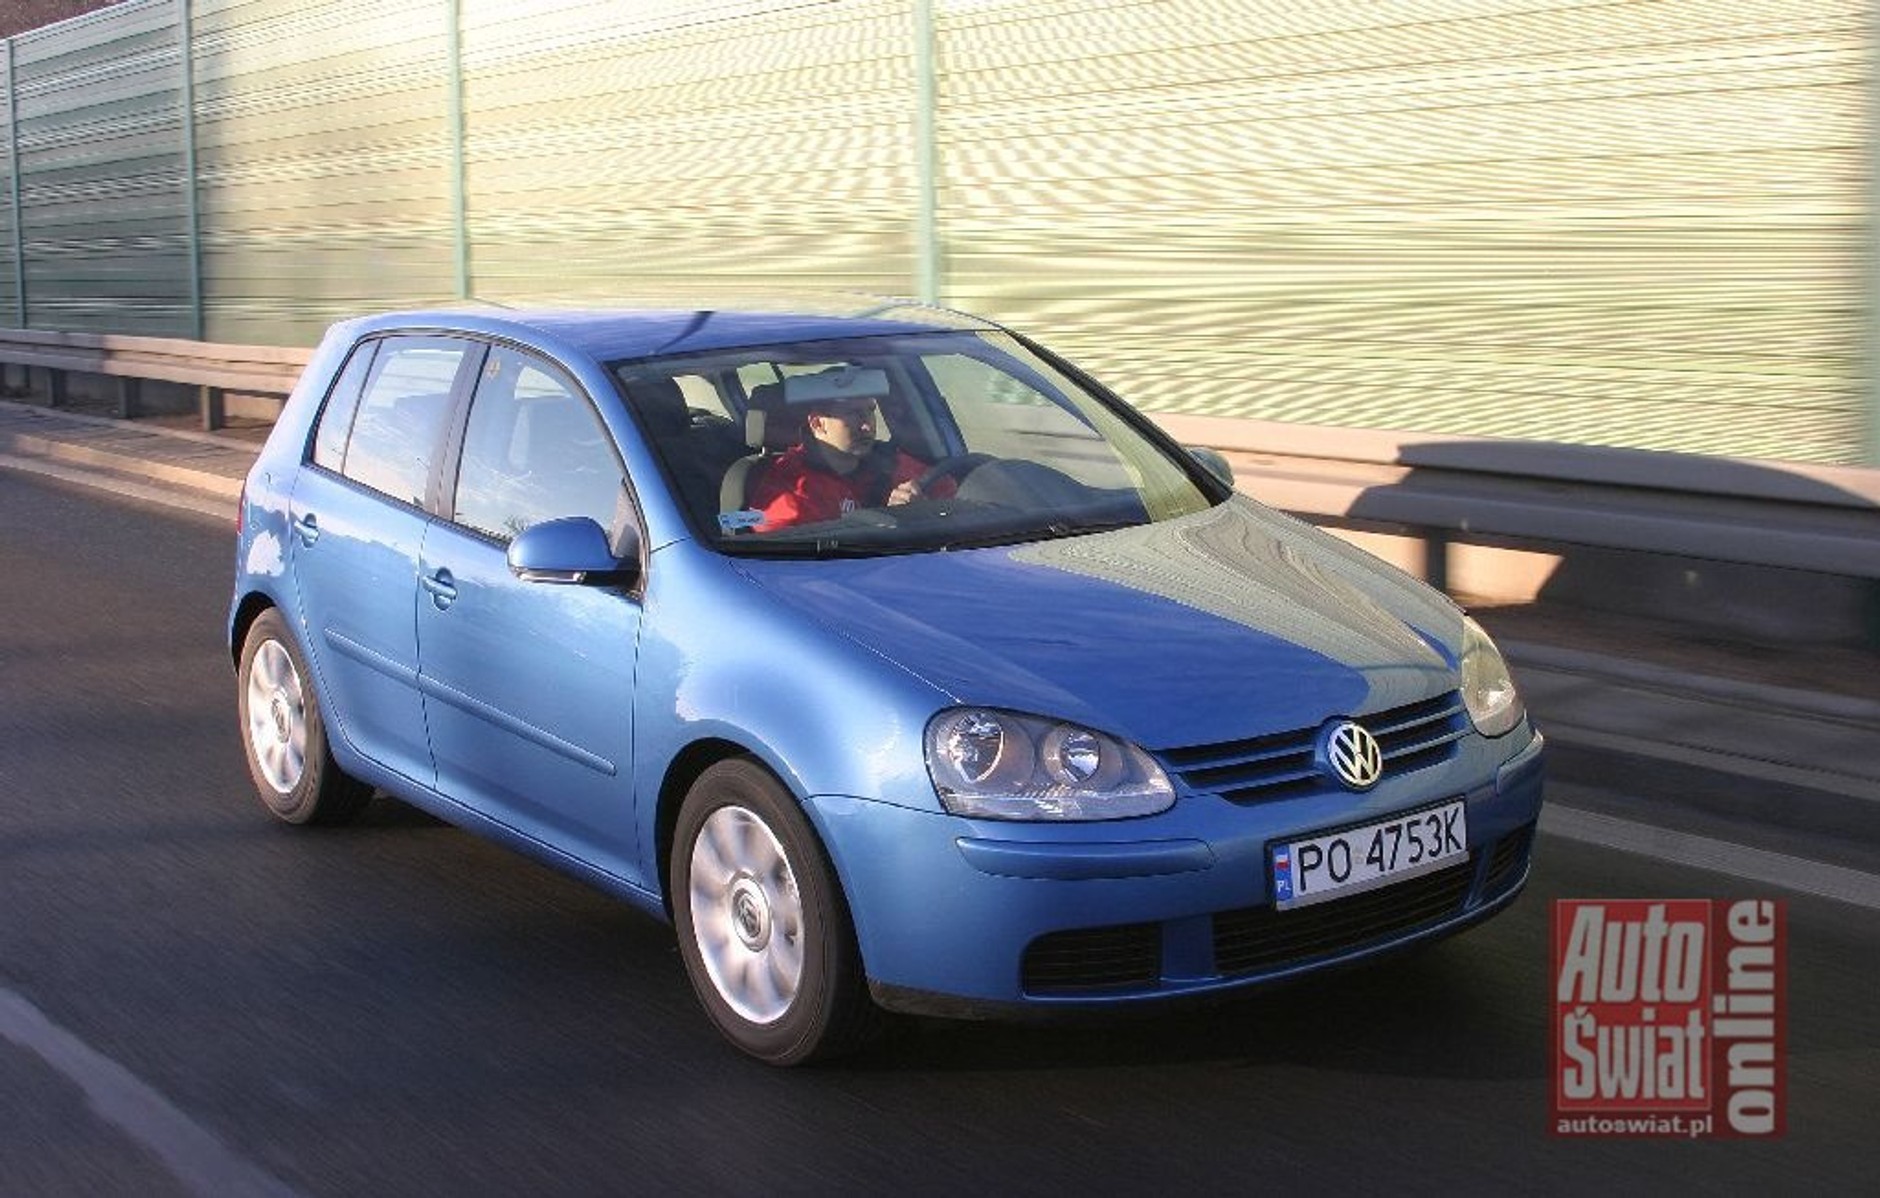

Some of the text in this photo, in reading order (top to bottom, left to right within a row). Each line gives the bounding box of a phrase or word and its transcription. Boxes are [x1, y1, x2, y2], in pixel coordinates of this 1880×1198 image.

[1328, 723, 1381, 786] VW
[1298, 806, 1462, 892] PO 4753K
[1277, 880, 1291, 892] PL
